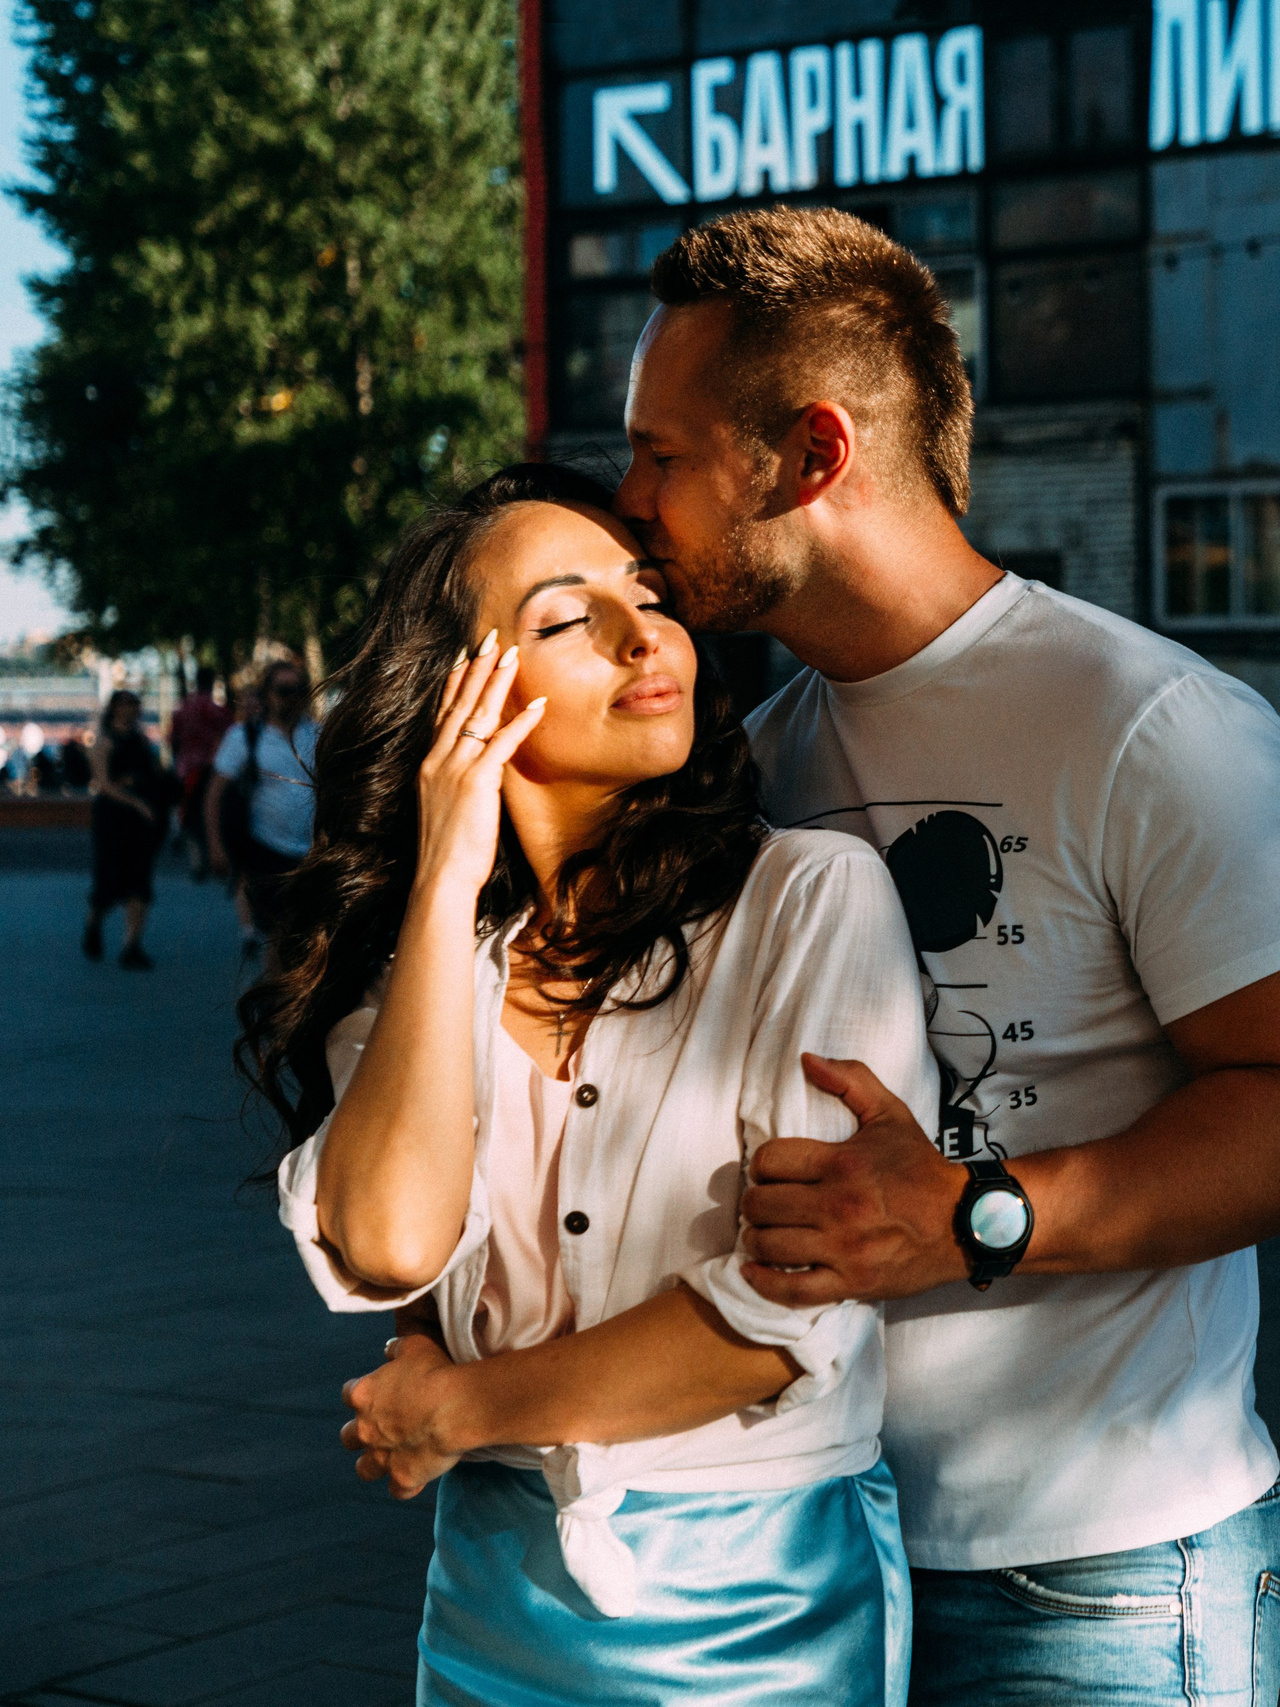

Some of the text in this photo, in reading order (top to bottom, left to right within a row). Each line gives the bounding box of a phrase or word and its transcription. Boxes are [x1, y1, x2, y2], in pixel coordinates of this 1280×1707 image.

[691, 24, 985, 202] БАРНАЯ
[1000, 836, 1028, 853] 65
[996, 924, 1025, 945] 55
[1002, 1020, 1035, 1042] 45
[1008, 1085, 1038, 1109] 35
